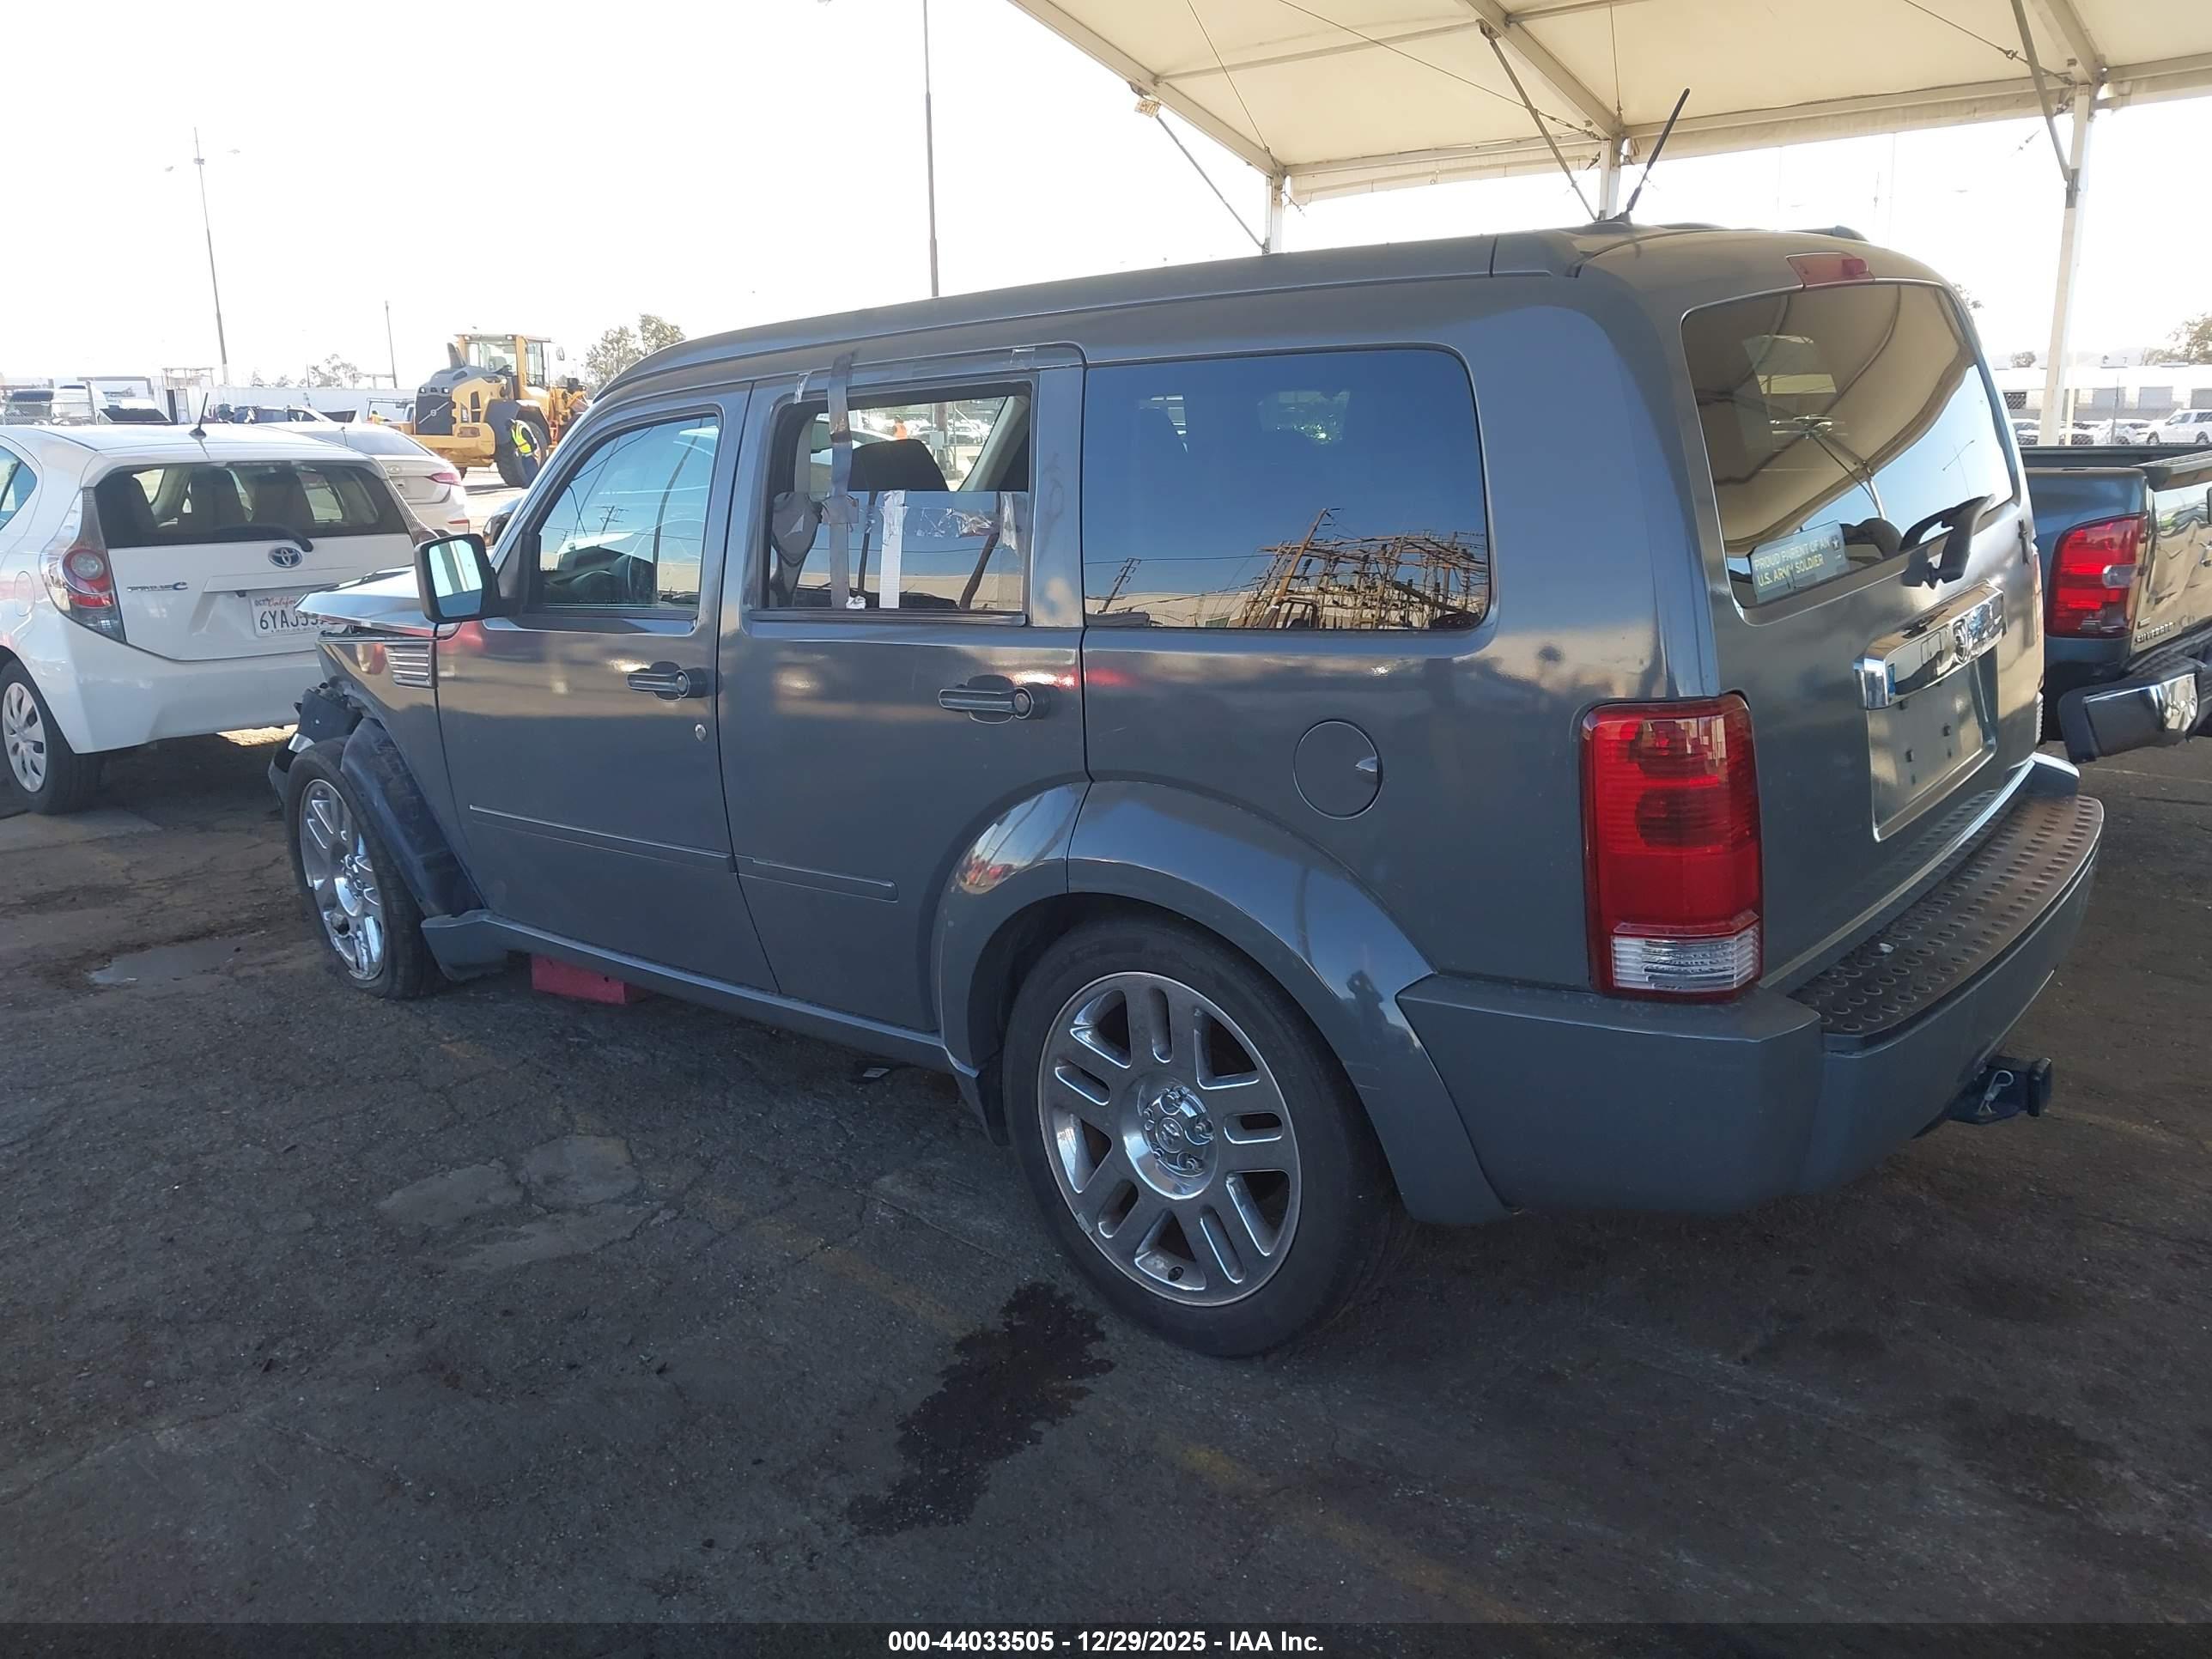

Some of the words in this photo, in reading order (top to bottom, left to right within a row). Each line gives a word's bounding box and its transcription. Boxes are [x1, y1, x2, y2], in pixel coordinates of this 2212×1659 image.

[1754, 553, 1781, 570] PROUD
[1781, 543, 1808, 561] PARENT
[1809, 538, 1819, 552] OF
[1820, 537, 1831, 550] AN
[1757, 572, 1773, 586] U.S.
[1773, 562, 1794, 582] ARMY
[1795, 553, 1825, 574] SOLDIER
